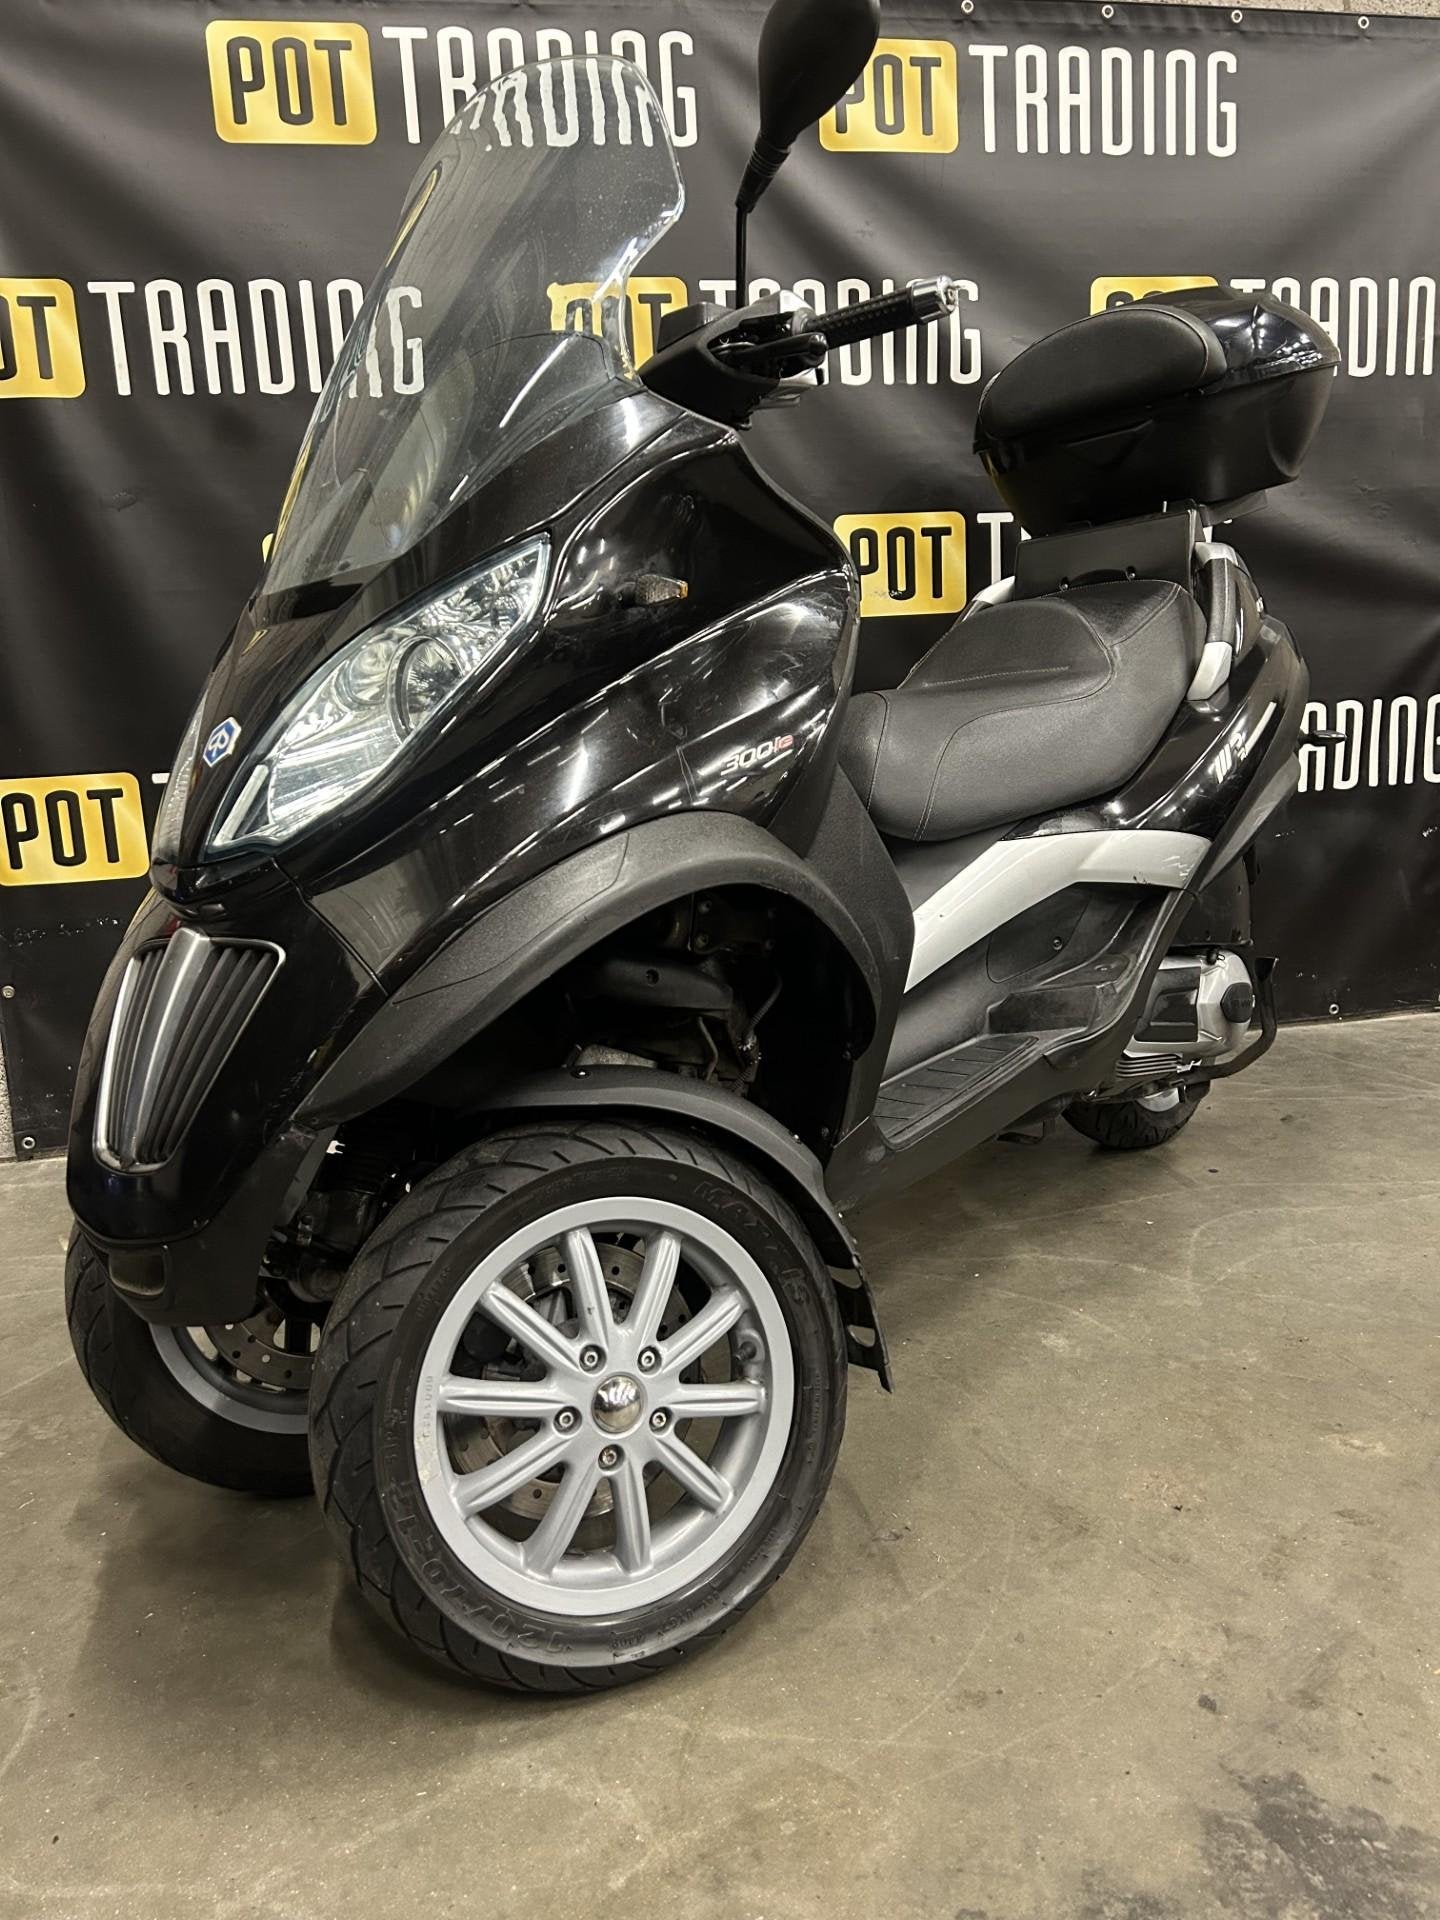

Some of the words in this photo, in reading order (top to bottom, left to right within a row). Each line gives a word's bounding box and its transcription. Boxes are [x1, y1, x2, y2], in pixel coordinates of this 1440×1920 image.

[227, 36, 353, 126] POT
[382, 26, 698, 147] TRADING
[968, 44, 1238, 157] TRADING
[87, 278, 425, 398] TRADING
[850, 527, 952, 600] POT
[1, 788, 123, 869] POT
